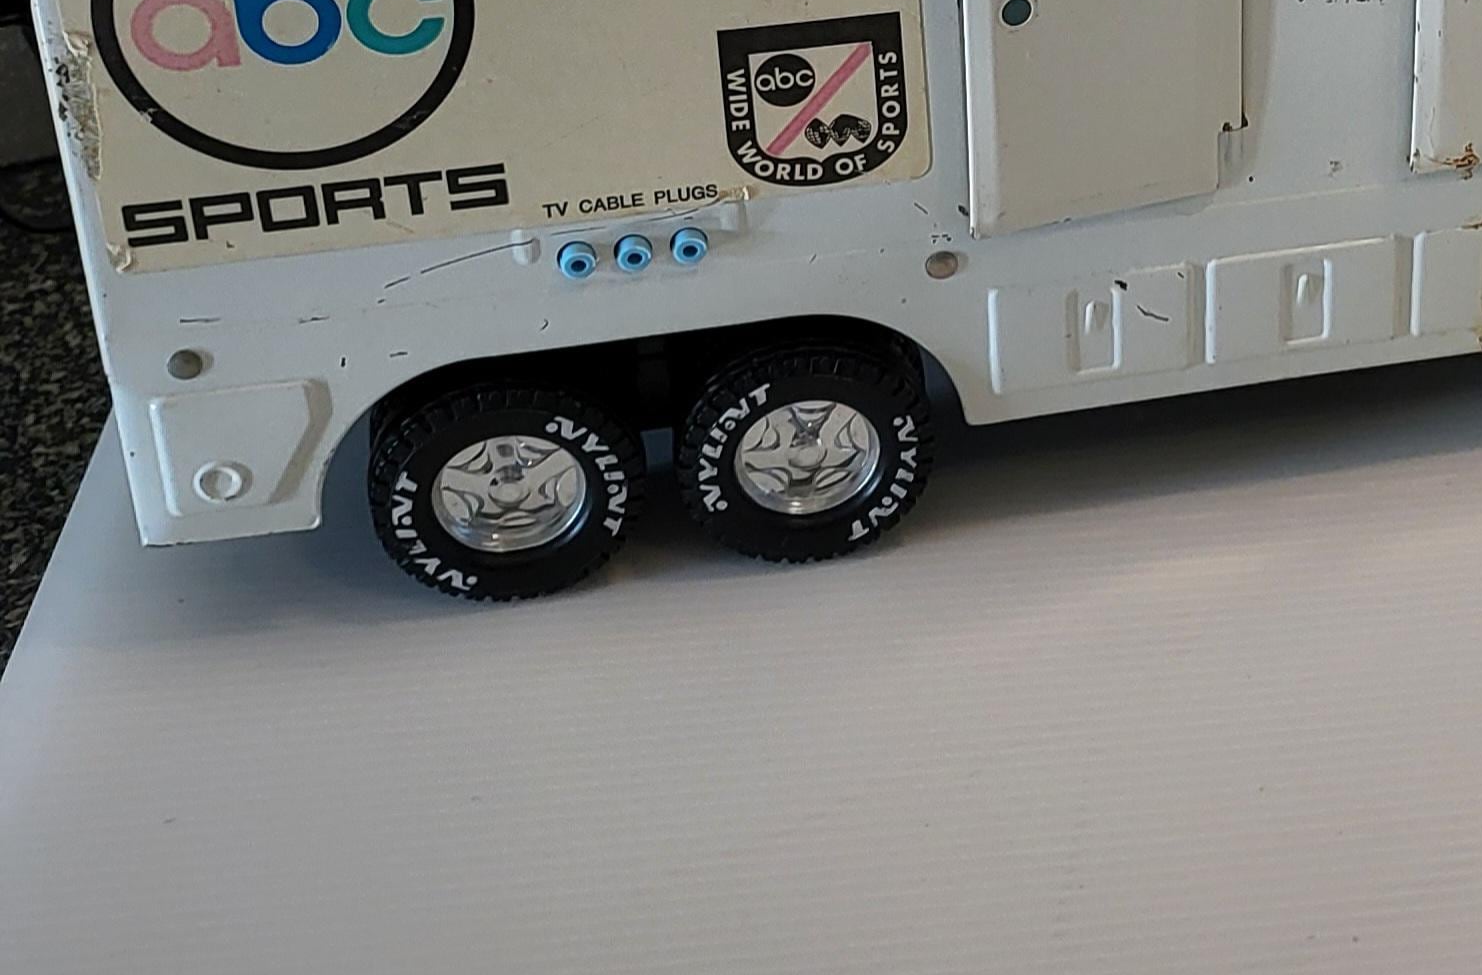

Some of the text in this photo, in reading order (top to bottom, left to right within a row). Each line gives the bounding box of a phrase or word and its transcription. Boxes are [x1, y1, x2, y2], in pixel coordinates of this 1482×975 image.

[727, 50, 901, 181] WIDE WORLD OF SPORTS
[754, 60, 815, 92] abc
[121, 162, 510, 248] SPORTS
[542, 184, 719, 219] TV CABLE PLUGS
[545, 415, 629, 537] NYLINT
[698, 382, 770, 513] NYLINT
[848, 413, 919, 542] NYLINT
[391, 470, 478, 591] NYLINT
